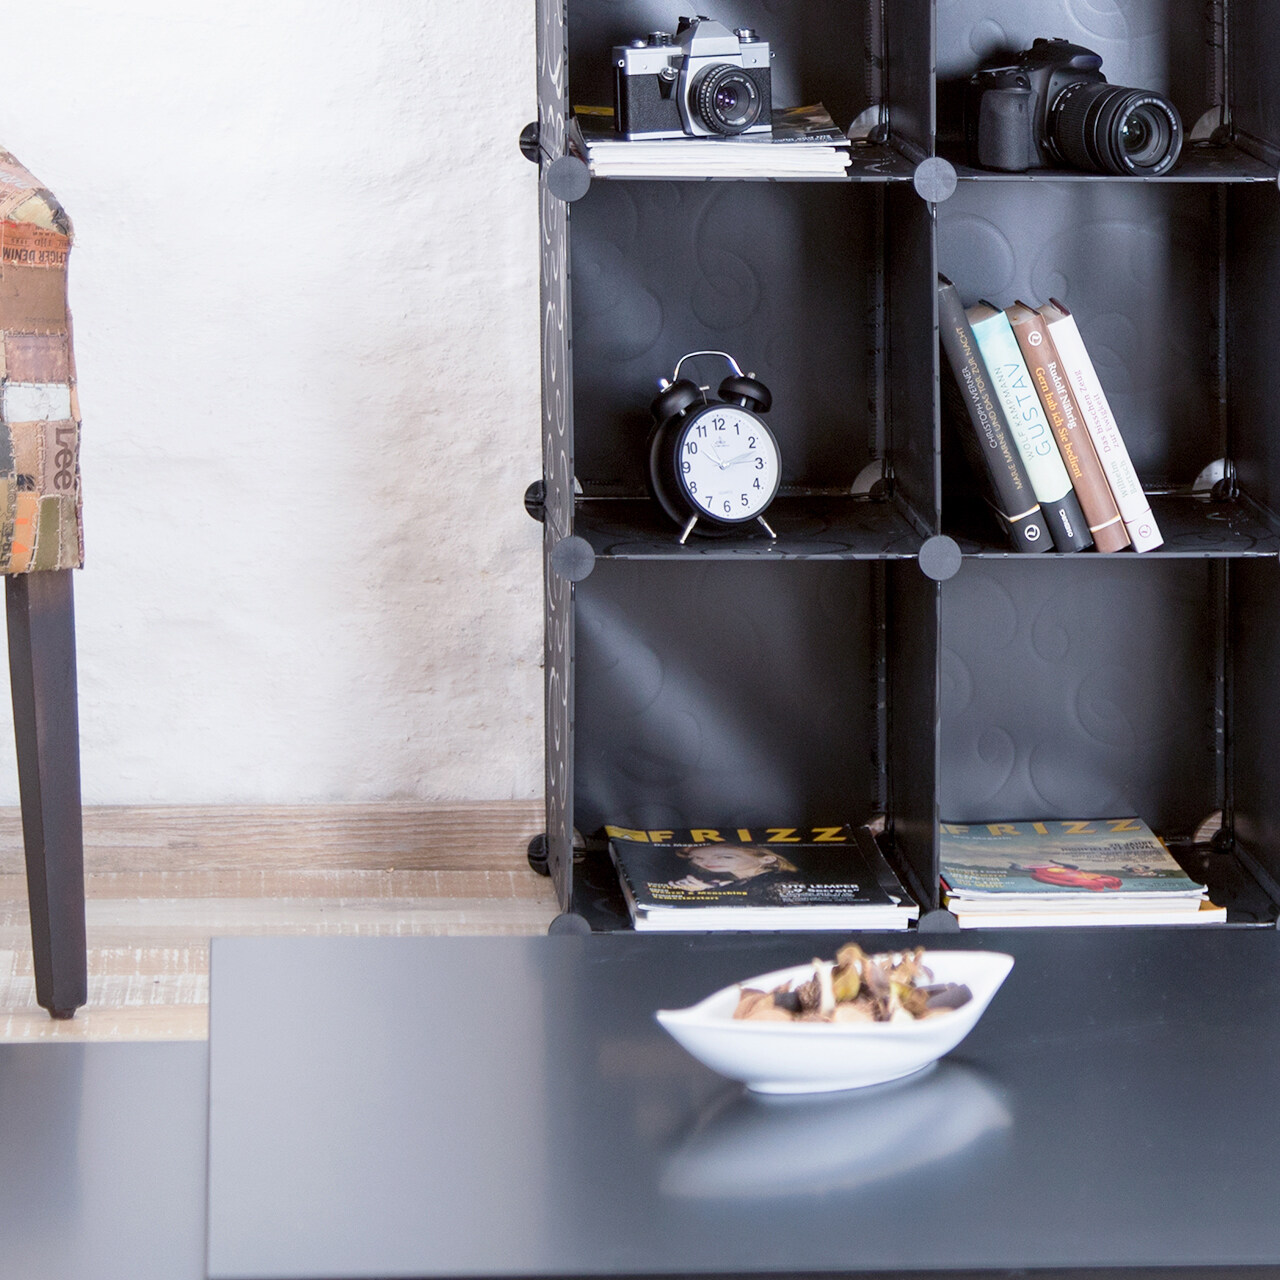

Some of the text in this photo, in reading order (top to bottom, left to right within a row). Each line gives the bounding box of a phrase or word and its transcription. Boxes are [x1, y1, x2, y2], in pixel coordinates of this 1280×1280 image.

[1047, 361, 1065, 395] Rudolf
[956, 326, 1023, 490] MARIE MARNE UND DAS TOR ZUR NACHT
[962, 365, 997, 449] CHRISTOPH WERNER
[995, 367, 1035, 461] WOLF KAMPMANN
[1004, 363, 1051, 456] GUSTAV
[1074, 369, 1111, 453] Das bisschen Zeug
[712, 418, 726, 431] 12
[734, 423, 740, 435] 1
[1035, 367, 1083, 479] Gern hab ich Sie bedient
[1093, 393, 1119, 448] zur Ewigkeit
[696, 425, 708, 438] 11
[685, 441, 698, 455] 10
[748, 436, 756, 449] 2
[53, 426, 75, 491] Lee
[755, 457, 764, 470] 3
[682, 461, 691, 474] 9
[753, 477, 760, 490] 4
[1111, 461, 1128, 498] Wilhelm
[1120, 461, 1137, 495] Bartsch
[689, 481, 698, 494] 8
[705, 496, 713, 509] 7
[723, 500, 731, 512] 6
[741, 493, 749, 506] 5
[647, 826, 848, 843] FRIZZ
[946, 819, 1142, 837] FRIZZ
